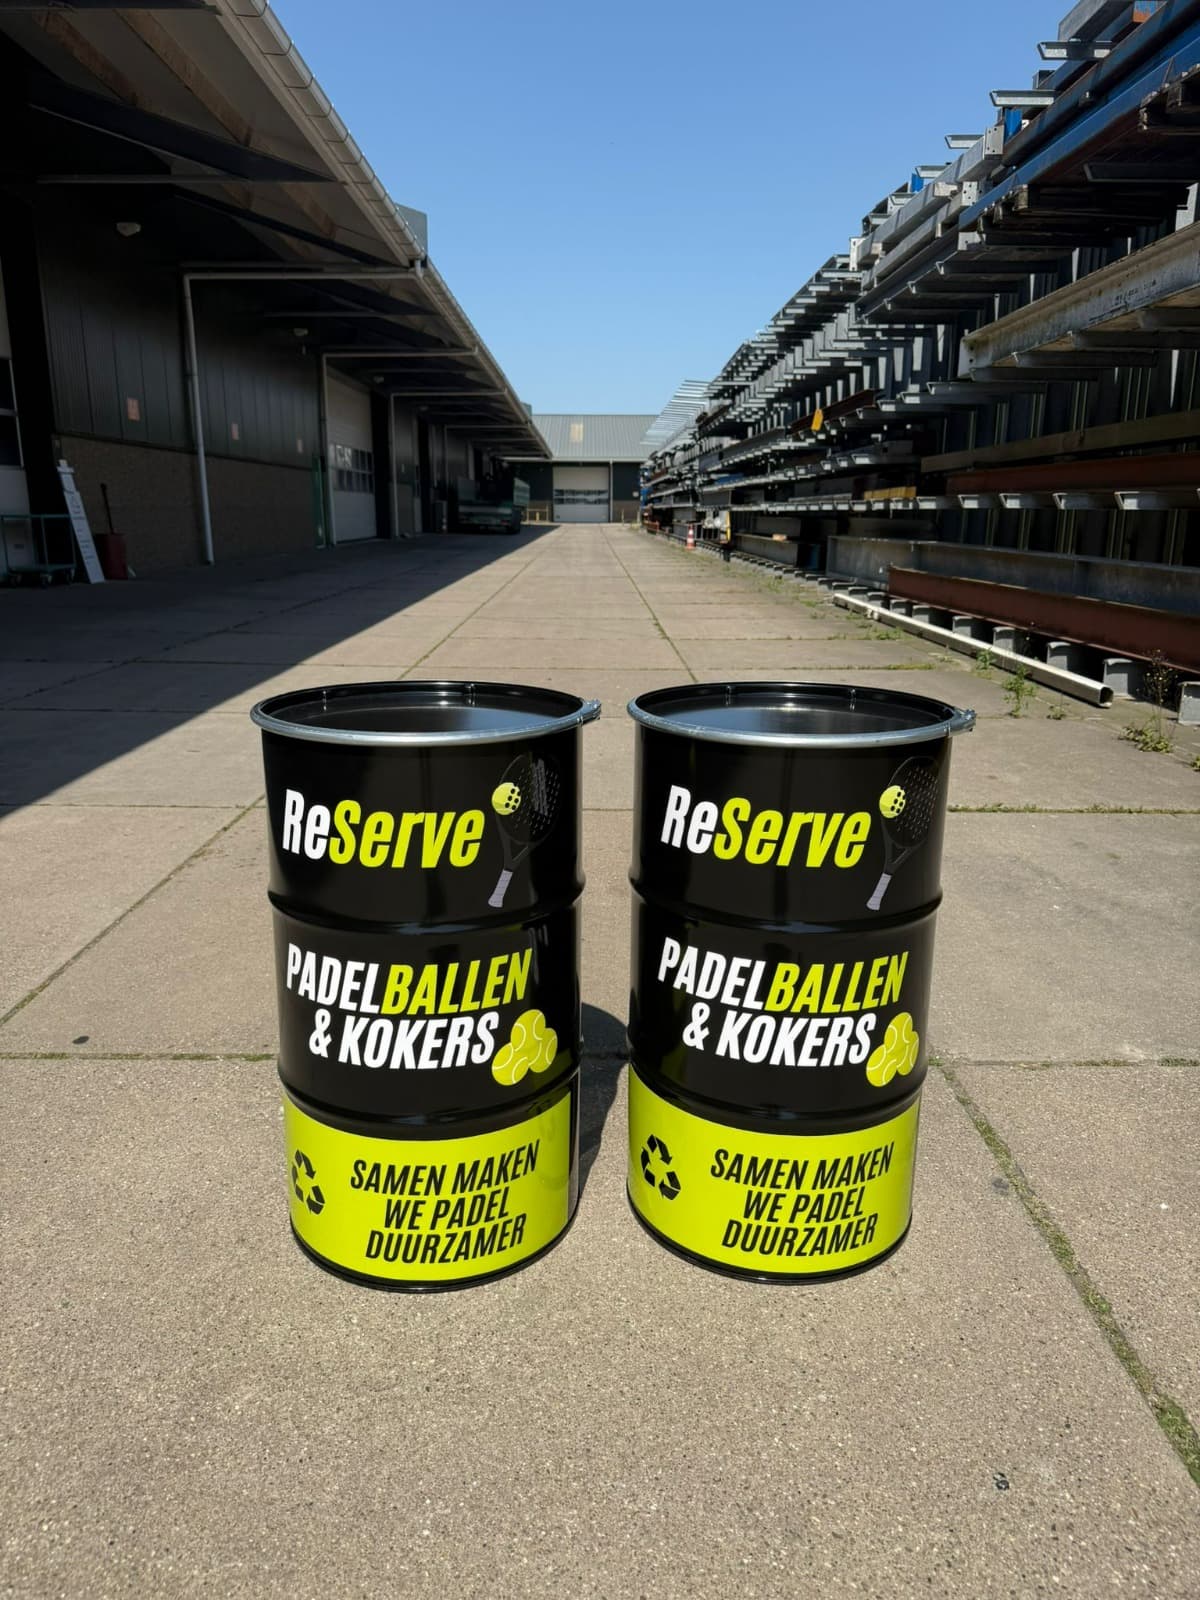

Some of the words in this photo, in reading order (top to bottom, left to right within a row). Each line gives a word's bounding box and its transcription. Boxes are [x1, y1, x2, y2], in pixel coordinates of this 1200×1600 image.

[283, 788, 485, 869] ReServe
[660, 784, 872, 869] ReServe
[286, 942, 533, 1016] PADELBALLEN
[657, 936, 909, 1014] PADELBALLEN
[308, 1008, 333, 1058] &
[338, 1011, 500, 1070] KOKERS
[682, 1002, 710, 1051] &
[715, 1009, 877, 1068] KOKERS
[350, 1159, 448, 1197] SAMEN
[451, 1138, 541, 1196] MAKEN
[710, 1148, 809, 1191] SAMEN
[812, 1141, 895, 1189] MAKEN
[383, 1198, 426, 1231] WE
[430, 1186, 510, 1231] PADEL
[721, 1212, 879, 1257] DUURZAMER
[742, 1189, 786, 1224] WE
[789, 1185, 866, 1224] PADEL
[366, 1212, 528, 1265] DUURZAMER
